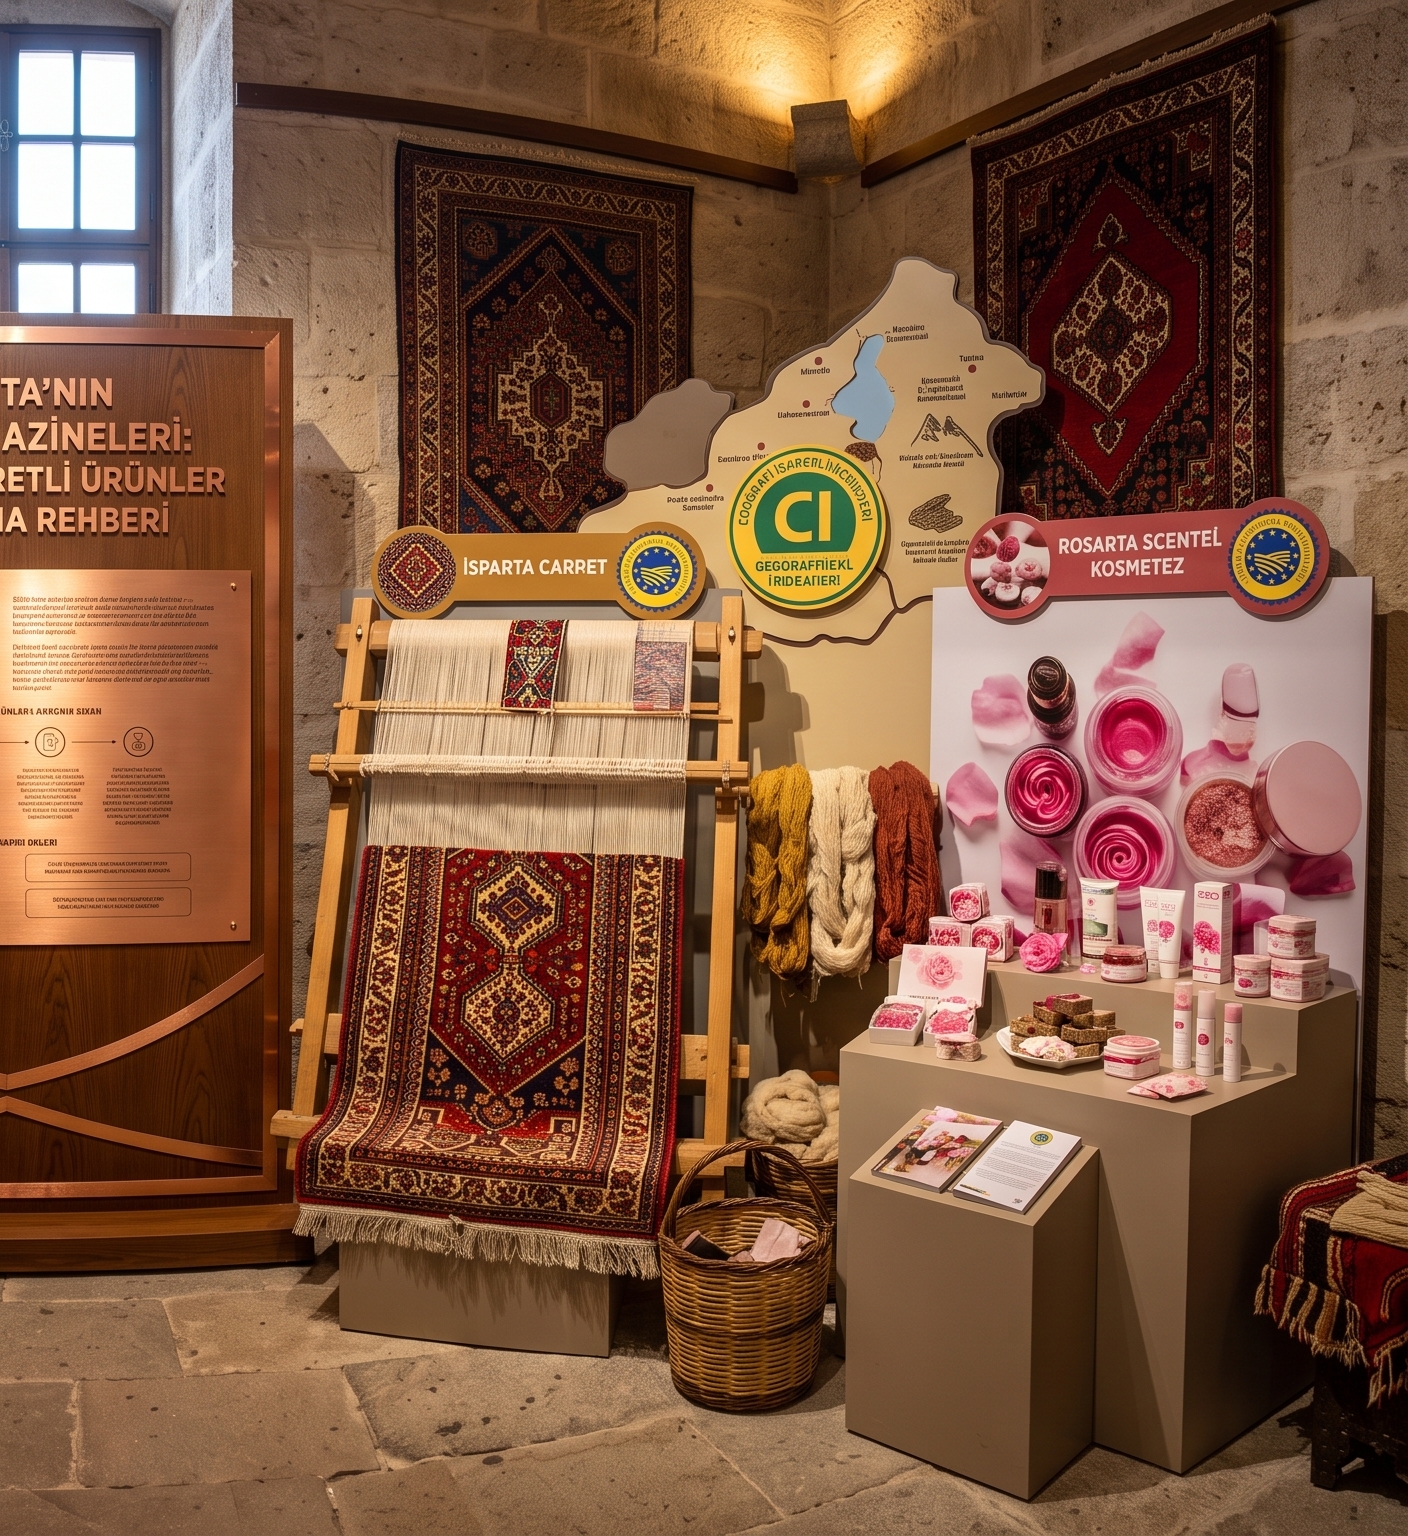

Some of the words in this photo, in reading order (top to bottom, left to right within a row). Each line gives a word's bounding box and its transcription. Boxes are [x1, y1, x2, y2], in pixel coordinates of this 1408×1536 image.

[81, 460, 226, 494] ÜRÜNLER
[37, 501, 169, 534] REHBERİ
[774, 490, 832, 543] CI
[1058, 534, 1139, 555] ROSARTA
[463, 556, 535, 576] İSPARTA
[539, 558, 608, 576] CARRET
[1090, 557, 1185, 579] KOSMETEZ
